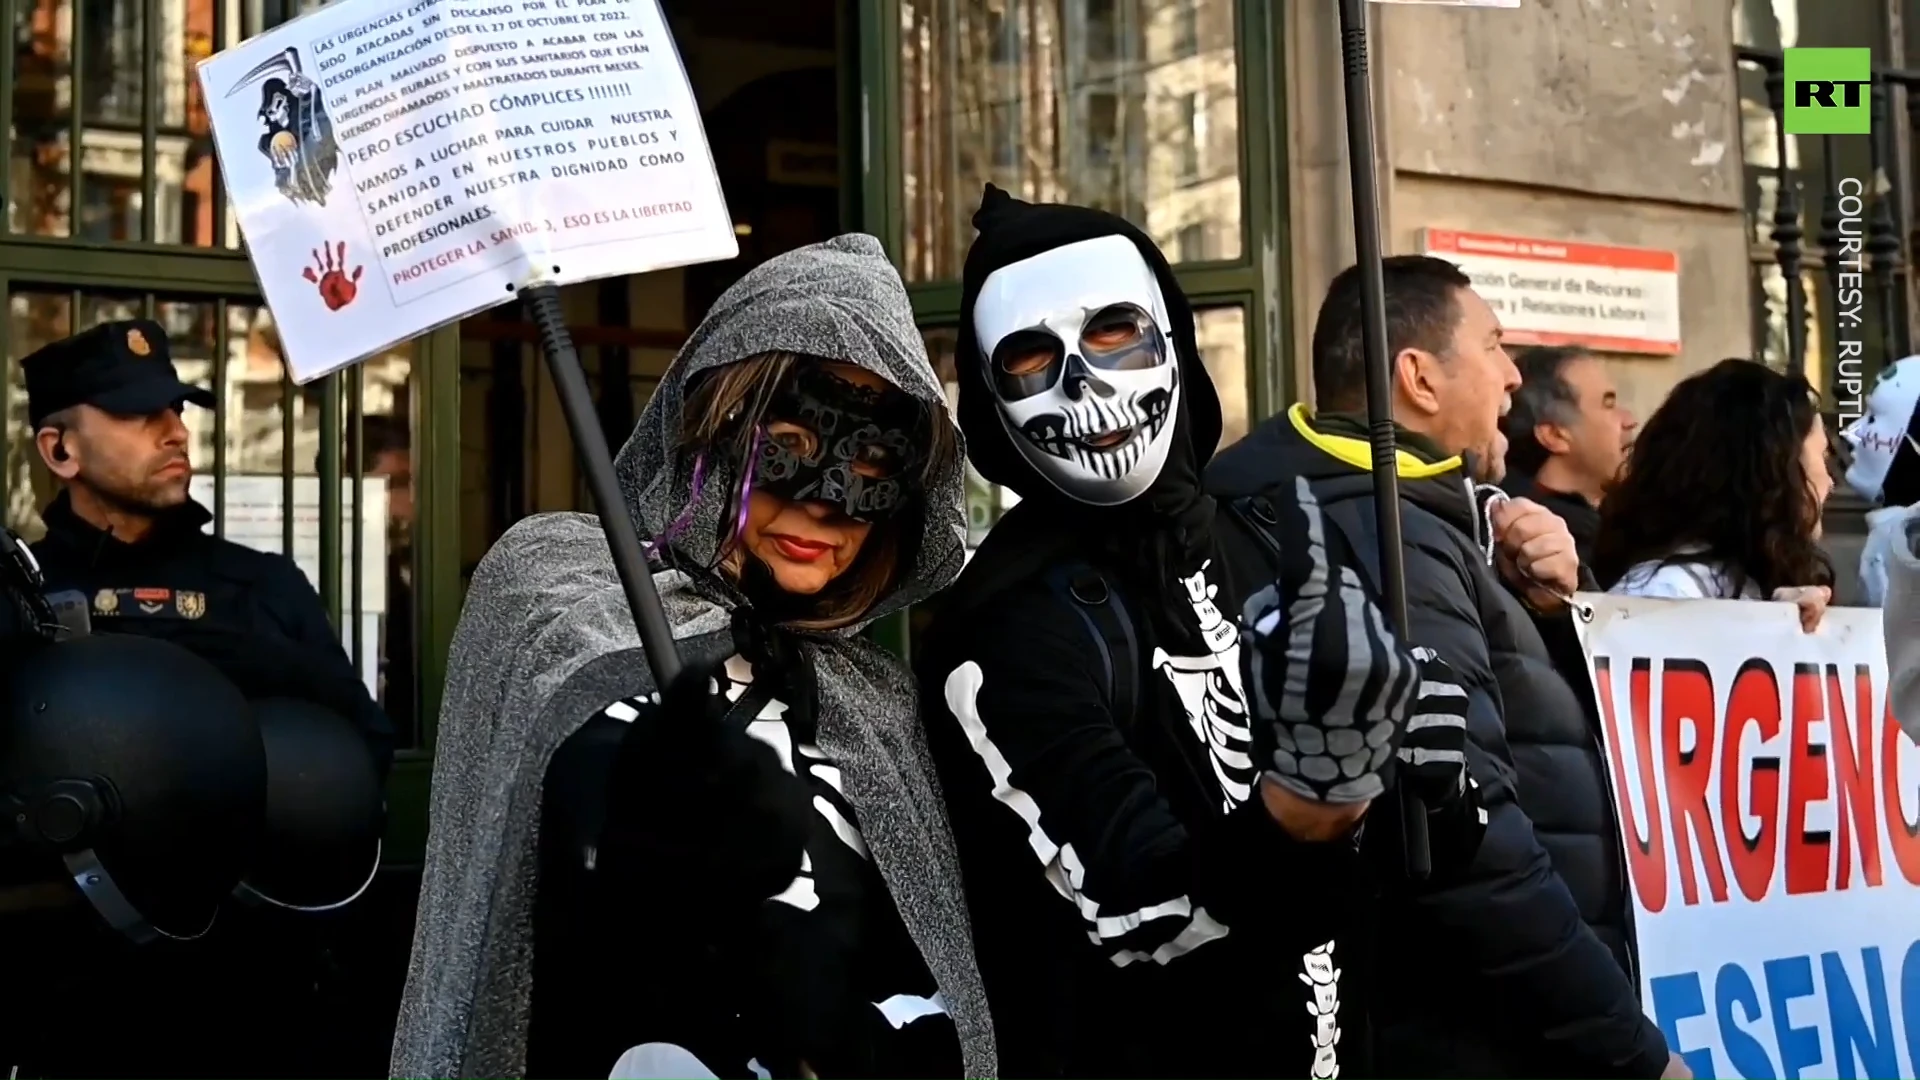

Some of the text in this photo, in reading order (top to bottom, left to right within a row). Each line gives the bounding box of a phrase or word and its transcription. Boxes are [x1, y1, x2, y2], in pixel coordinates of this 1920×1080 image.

[314, 39, 335, 54] LAS
[338, 11, 404, 44] URGENCIAS
[319, 53, 347, 72] SIDO
[356, 26, 414, 56] ATACADAS
[422, 13, 441, 28] SIN
[451, 5, 513, 19] DESCANSO
[523, 1, 547, 12] POR
[324, 11, 631, 88] DESORGANIZACIÓN DESDE EL 27 DE OCTUBRE DE 2022.
[330, 29, 644, 109] UN PLAN MALVADO DISPUESTO A ACABAR CON LAS
[335, 43, 650, 124] URGENCIAS RURALES Y CON SUS SANITARIOS QUE ESTÁN
[341, 60, 644, 141] SIENDO DIFAMADOS Y MALTRATADOS DURANTE MESES.
[348, 138, 391, 166] PERO
[395, 103, 484, 146] ESCUCHAD
[489, 88, 585, 113] CÓMPLICES
[356, 108, 673, 194] VAMOS A LUCHAR PARA CUIDAR NUESTRA
[367, 130, 678, 215] SANIDAD EN NUESTROS PUEBLOS Y
[375, 151, 685, 237] DEFENDER NUESTRA DIGNIDAD COMO
[393, 247, 465, 285] PROTEGER
[467, 240, 487, 256] LA
[563, 213, 591, 229] ESO
[595, 211, 610, 224] ES
[612, 209, 630, 221] LA
[632, 201, 693, 219] LIBERTAD
